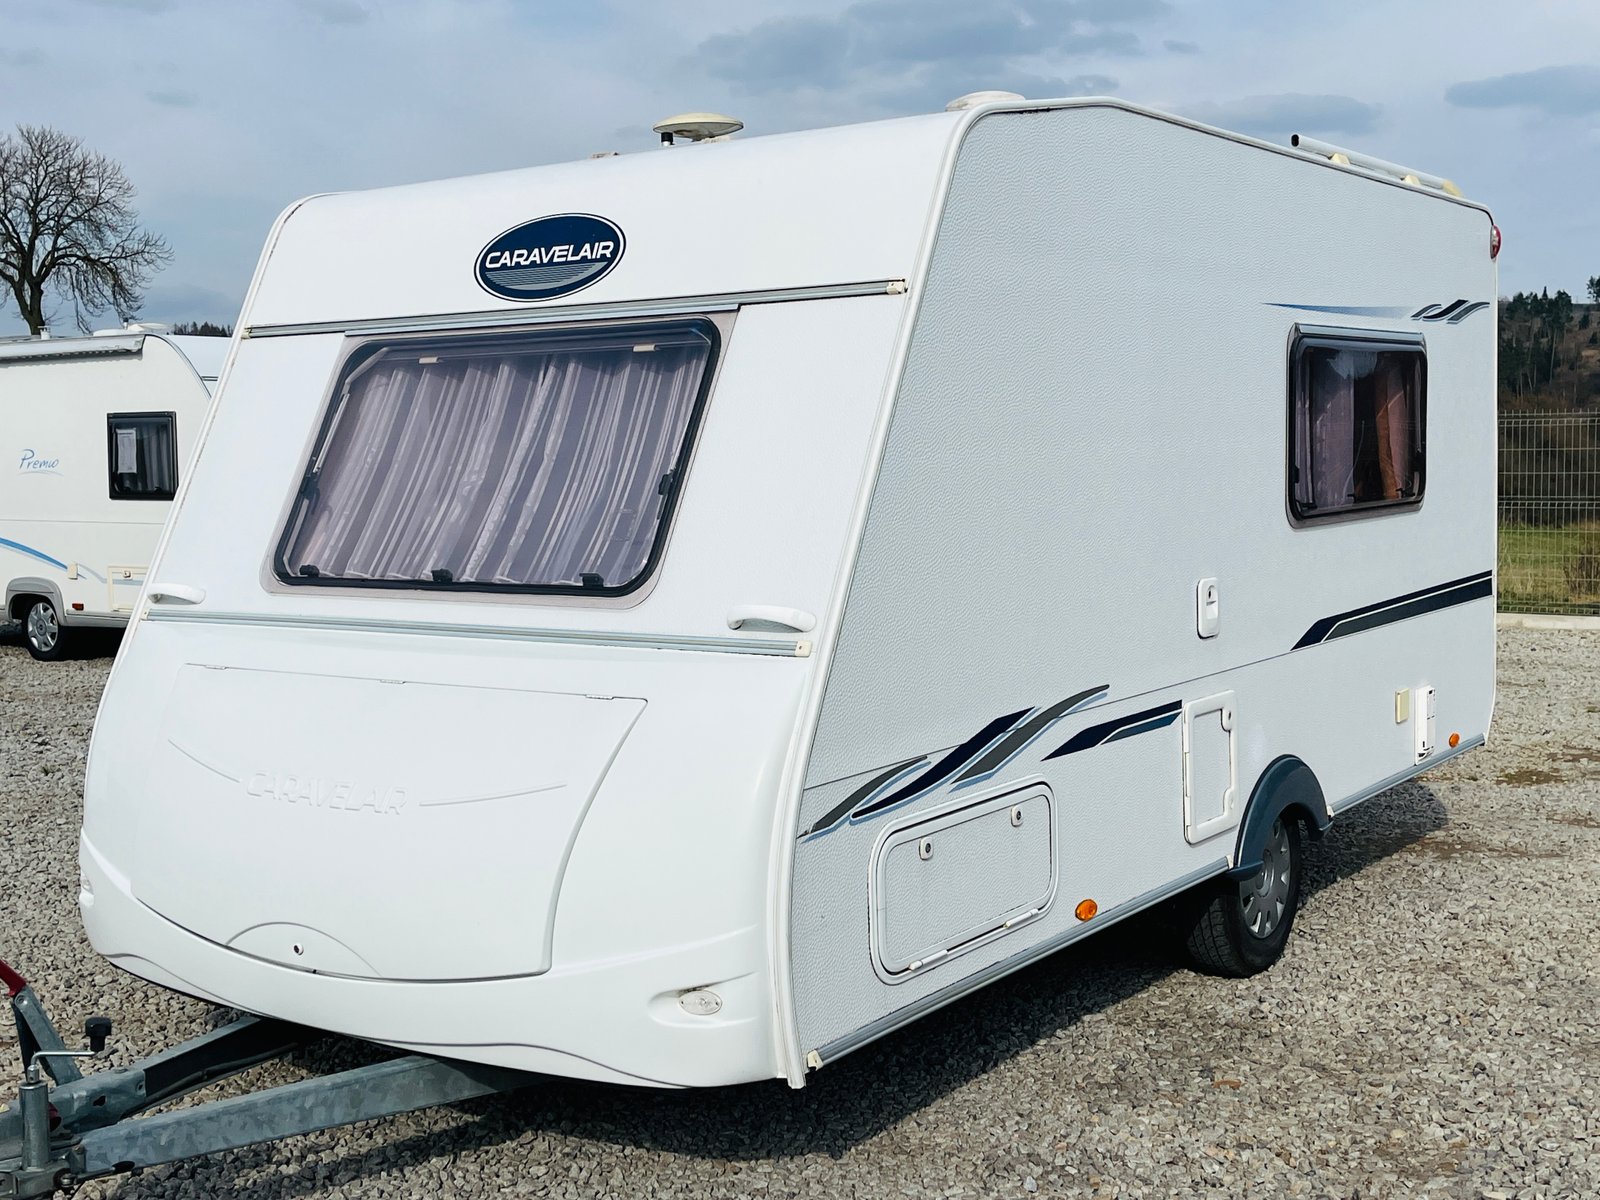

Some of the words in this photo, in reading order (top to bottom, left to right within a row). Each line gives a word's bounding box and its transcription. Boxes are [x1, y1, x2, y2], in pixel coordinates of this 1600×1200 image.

[485, 241, 614, 269] CARAVELAIR
[19, 448, 60, 469] Premio
[247, 771, 408, 815] CARAVELAIR
